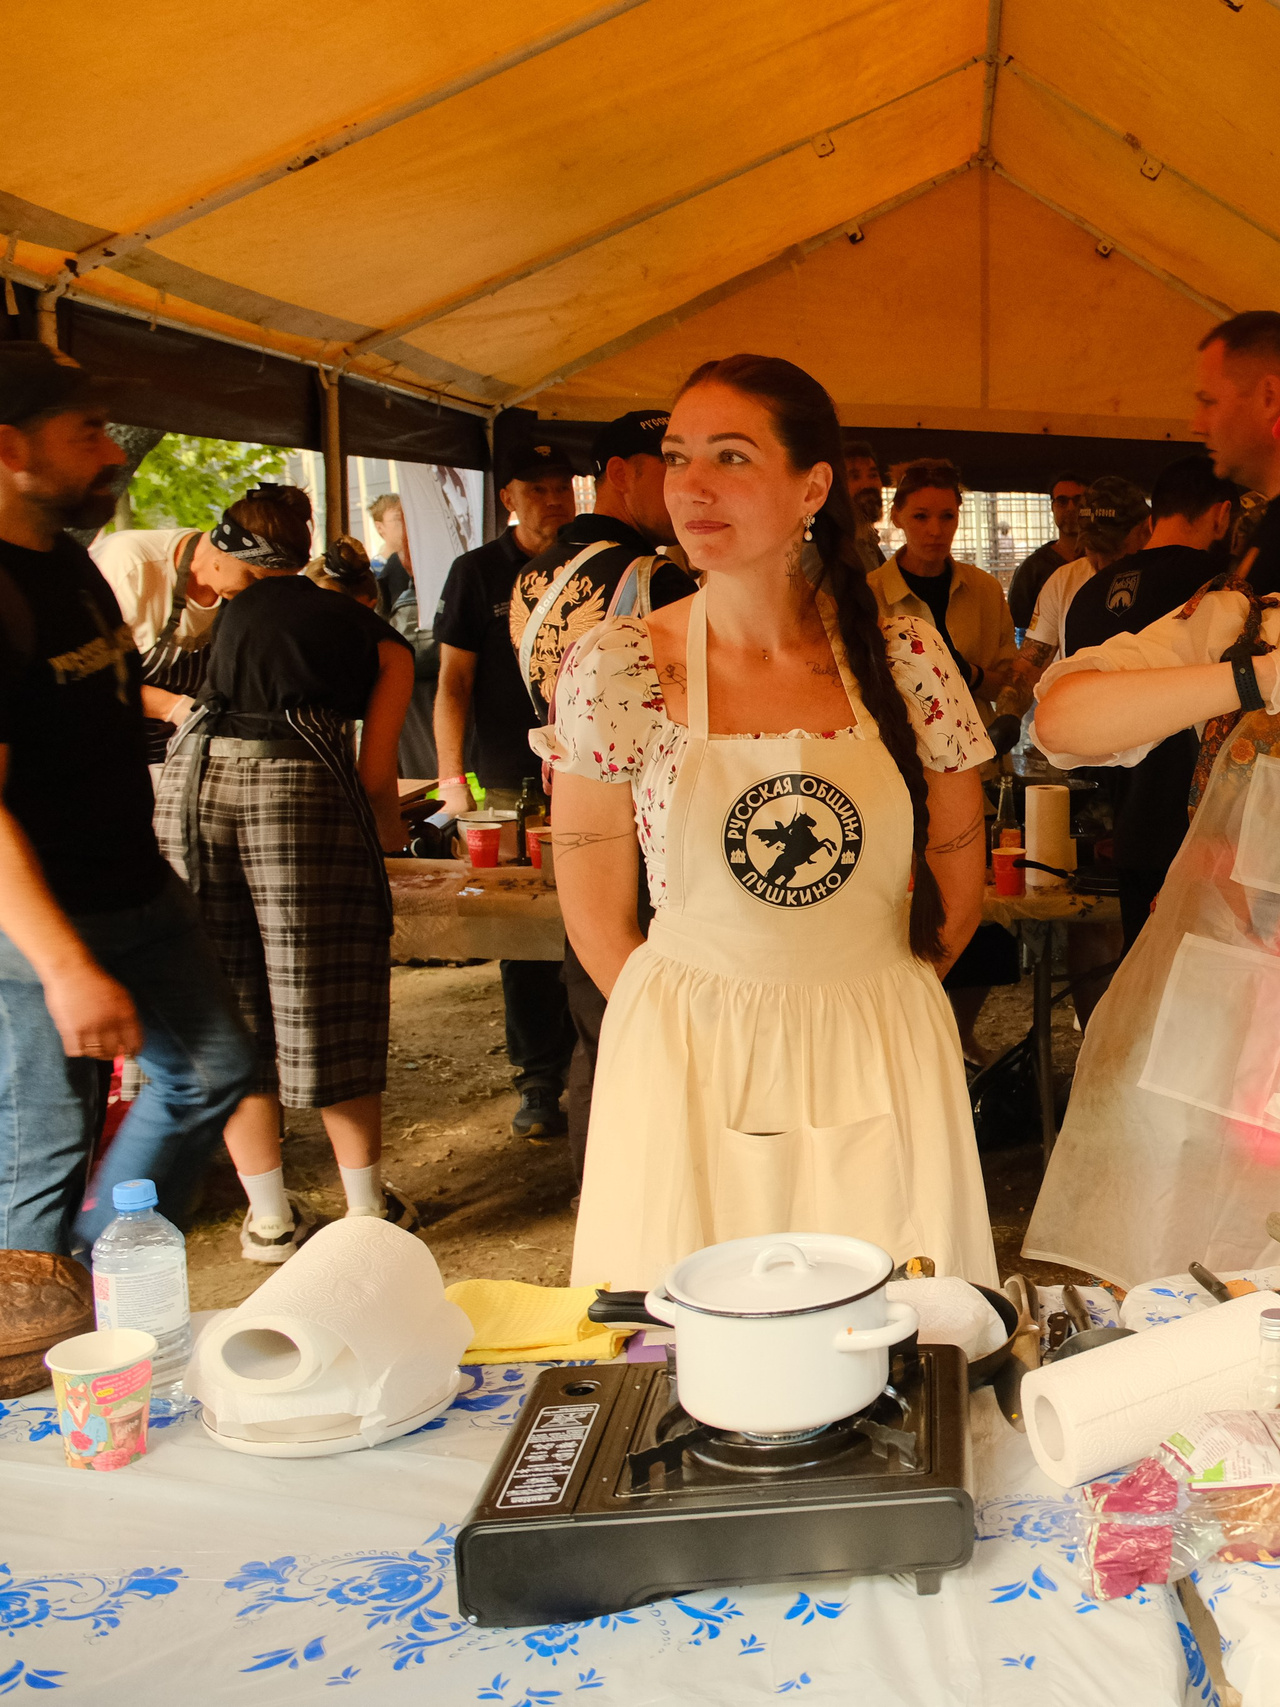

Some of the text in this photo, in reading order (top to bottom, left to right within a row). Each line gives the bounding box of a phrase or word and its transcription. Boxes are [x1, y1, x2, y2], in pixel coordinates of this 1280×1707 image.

[639, 416, 670, 430] РУССК
[727, 777, 860, 841] РУССКАЯ ОБЩИНА
[741, 871, 842, 906] ПУШКИНО
